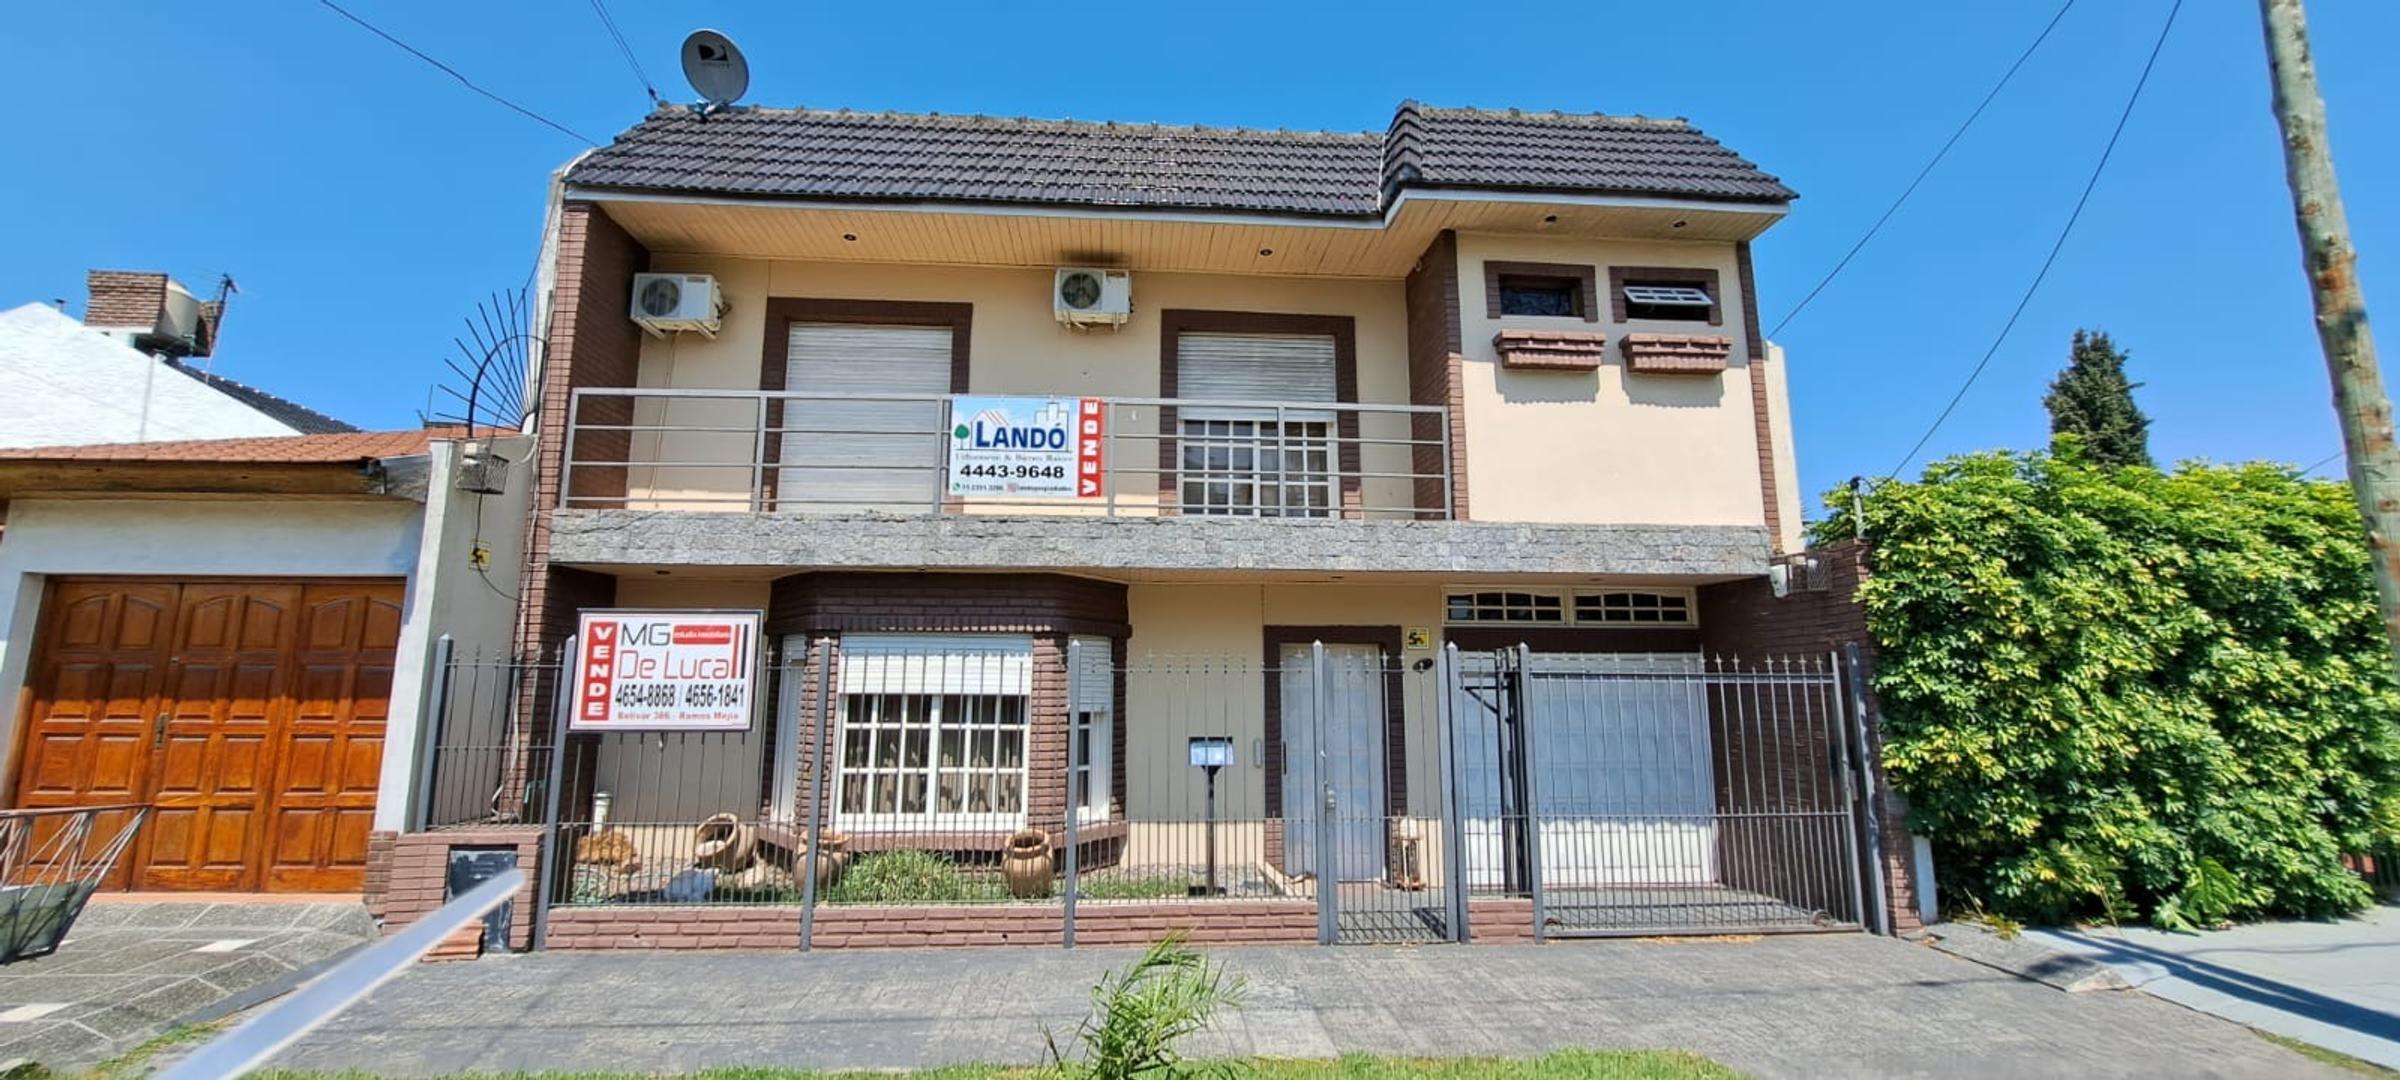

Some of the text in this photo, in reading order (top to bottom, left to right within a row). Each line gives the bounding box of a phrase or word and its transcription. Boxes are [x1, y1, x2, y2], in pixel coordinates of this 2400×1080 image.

[976, 421, 1065, 449] LANDÓ
[1081, 400, 1098, 494] VENDE
[960, 464, 1064, 478] 4443-9648
[620, 623, 671, 646] MG
[587, 626, 614, 716] VENDE
[618, 650, 656, 679] De
[616, 684, 675, 707] 4654-8868
[686, 684, 744, 707] 4656-1841
